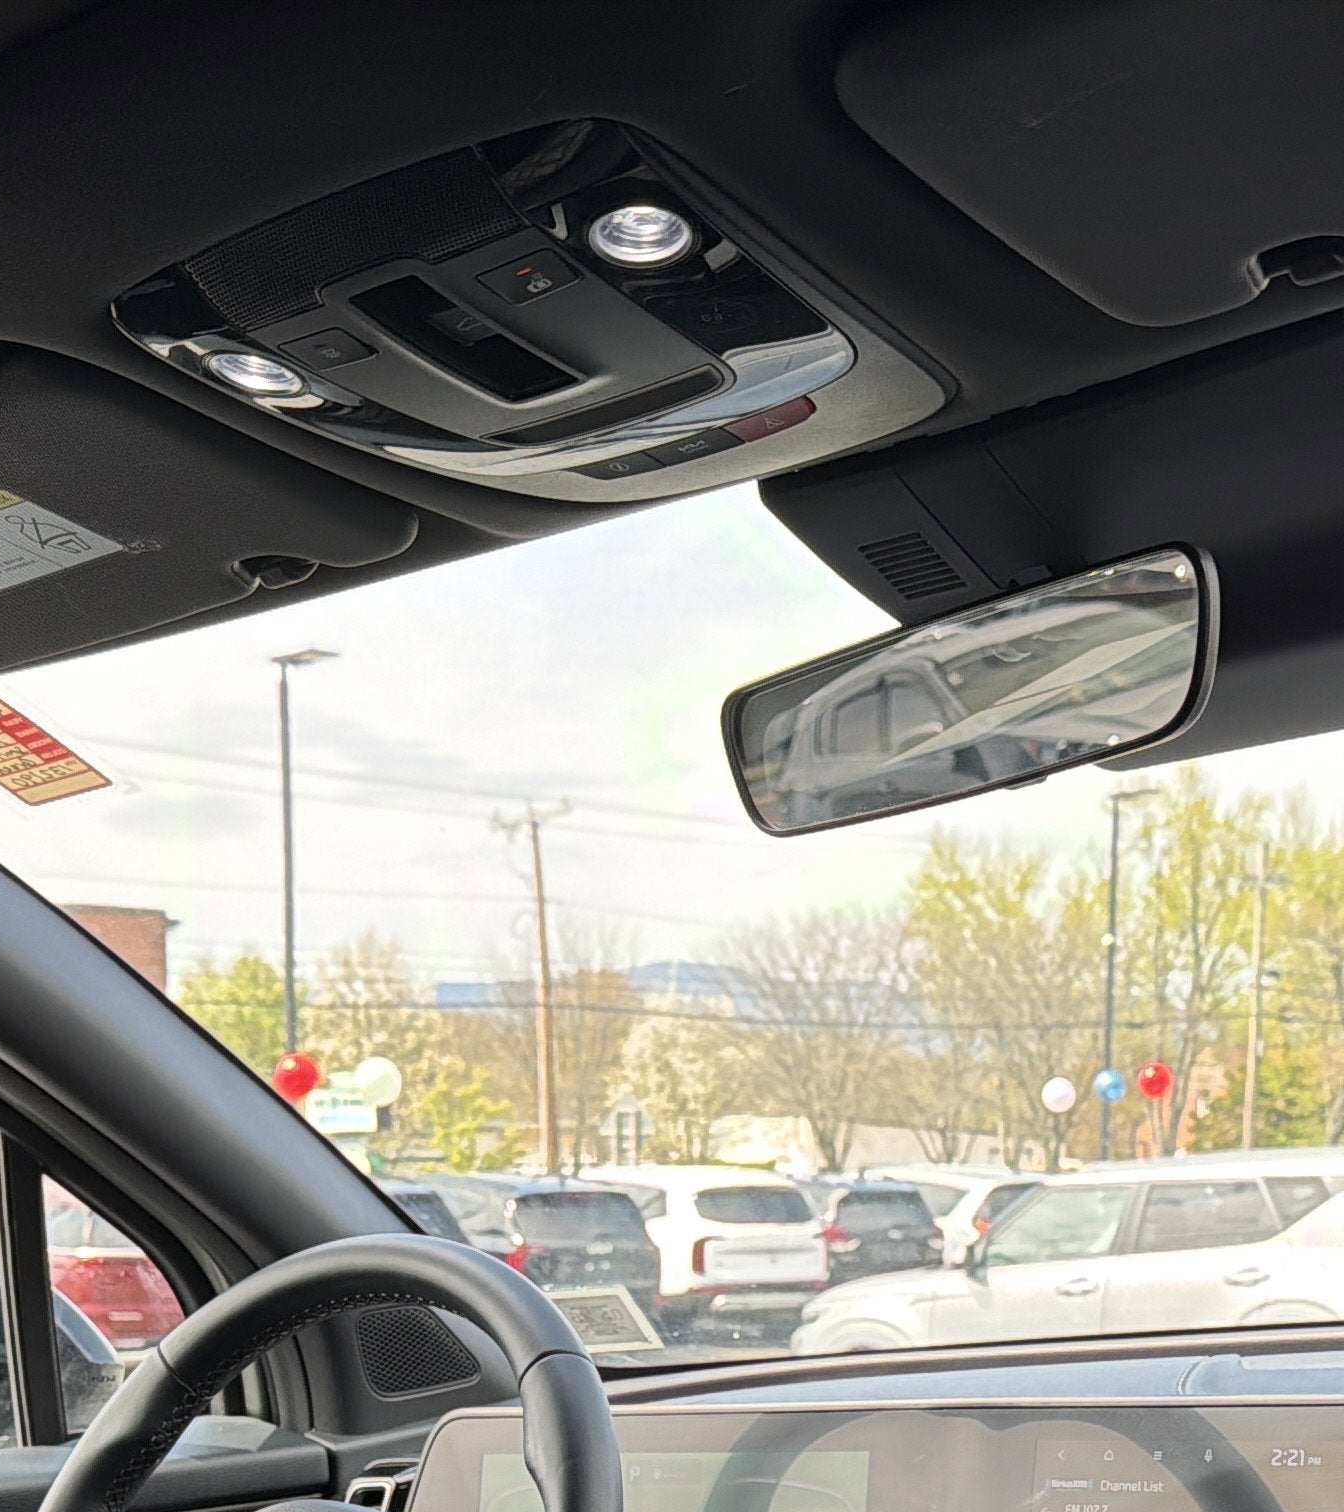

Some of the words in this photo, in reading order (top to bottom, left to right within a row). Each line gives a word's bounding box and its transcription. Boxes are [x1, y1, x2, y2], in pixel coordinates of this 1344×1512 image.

[1271, 1448, 1305, 1466] 2:21
[1308, 1457, 1321, 1466] PM
[629, 1465, 640, 1482] P
[1100, 1480, 1142, 1492] Channel
[1144, 1481, 1165, 1493] List
